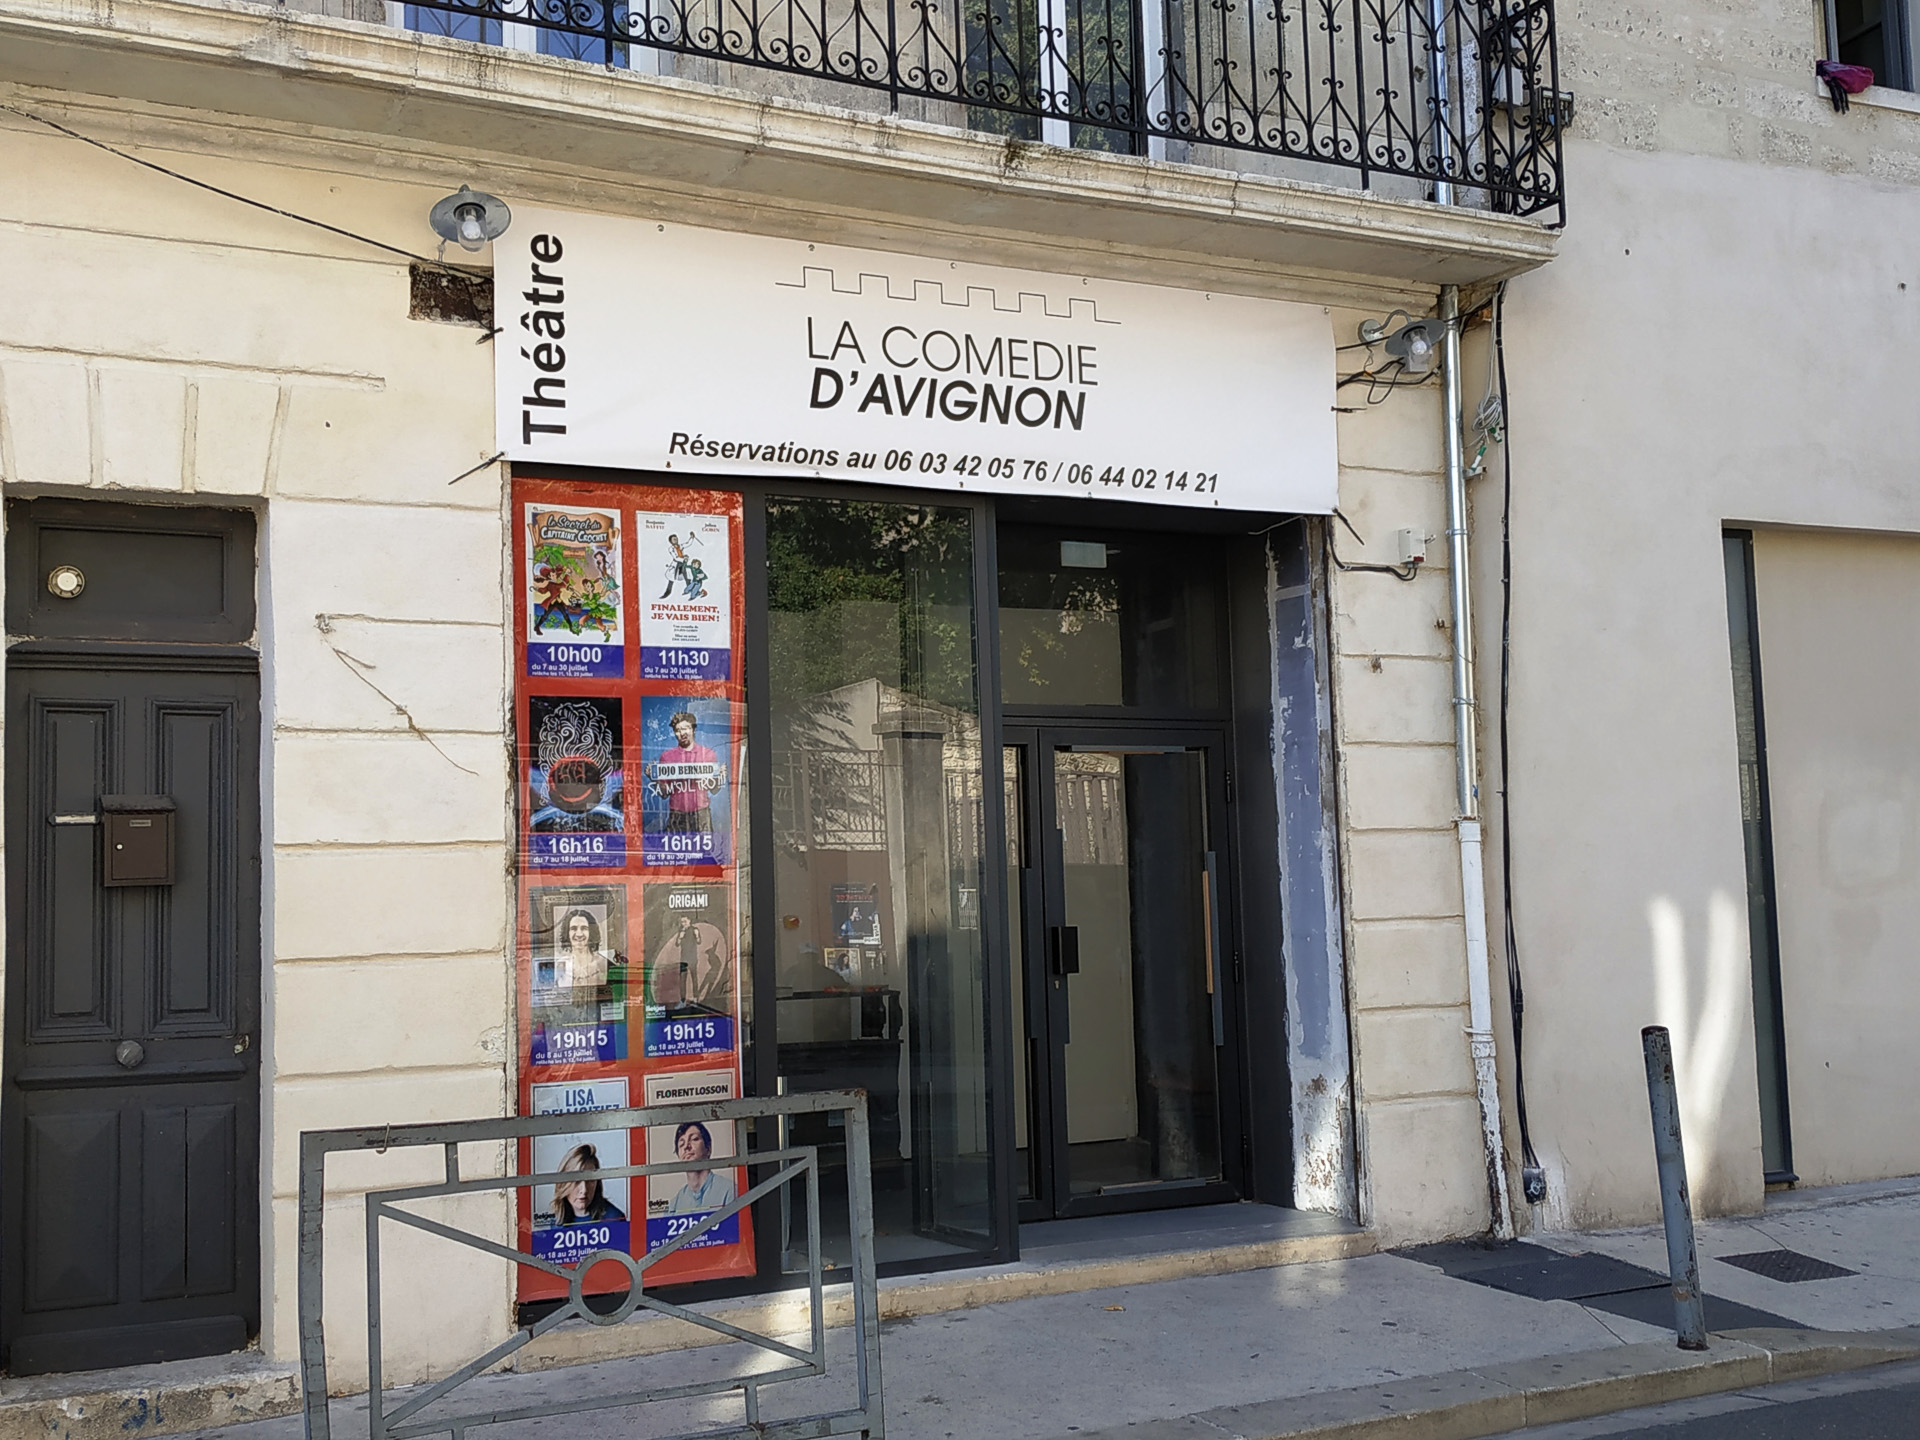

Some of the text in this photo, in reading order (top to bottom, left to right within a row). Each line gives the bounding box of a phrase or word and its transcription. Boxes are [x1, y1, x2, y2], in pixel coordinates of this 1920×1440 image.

[520, 234, 566, 445] Théâtre
[807, 316, 1098, 386] LA COMEDIE
[810, 367, 1086, 430] D'AVIGNON
[669, 432, 839, 467] Réservations
[846, 451, 877, 469] au
[884, 449, 913, 472] 06
[919, 452, 947, 474] 03
[953, 455, 982, 476] 42
[988, 457, 1015, 479] 05
[1022, 459, 1048, 481] 76
[1067, 463, 1093, 485] 06
[1099, 466, 1125, 487] 44
[1132, 468, 1157, 490] 02
[1164, 470, 1188, 491] 14
[1195, 472, 1218, 493] 21
[558, 515, 590, 529] Secret
[651, 604, 720, 614] FINALEMENT,
[547, 646, 601, 663] 10h00
[659, 650, 709, 666] 11h30
[658, 765, 714, 776] JOJO BERNARD
[648, 782, 662, 796] SA
[696, 776, 716, 791] TRO
[549, 837, 603, 854] 16h16
[662, 835, 712, 851] 16h15
[570, 856, 589, 864] juillet
[669, 894, 708, 908] ORIGAMI
[553, 1030, 608, 1048] 19h15
[664, 1022, 714, 1041] 19h15
[686, 1041, 704, 1049] juillet
[573, 1050, 592, 1058] juillet
[565, 1088, 595, 1107] LISA
[656, 1085, 728, 1099] FLORENT LOSSON
[667, 1215, 720, 1236] 22h
[554, 1227, 609, 1249] 20h30
